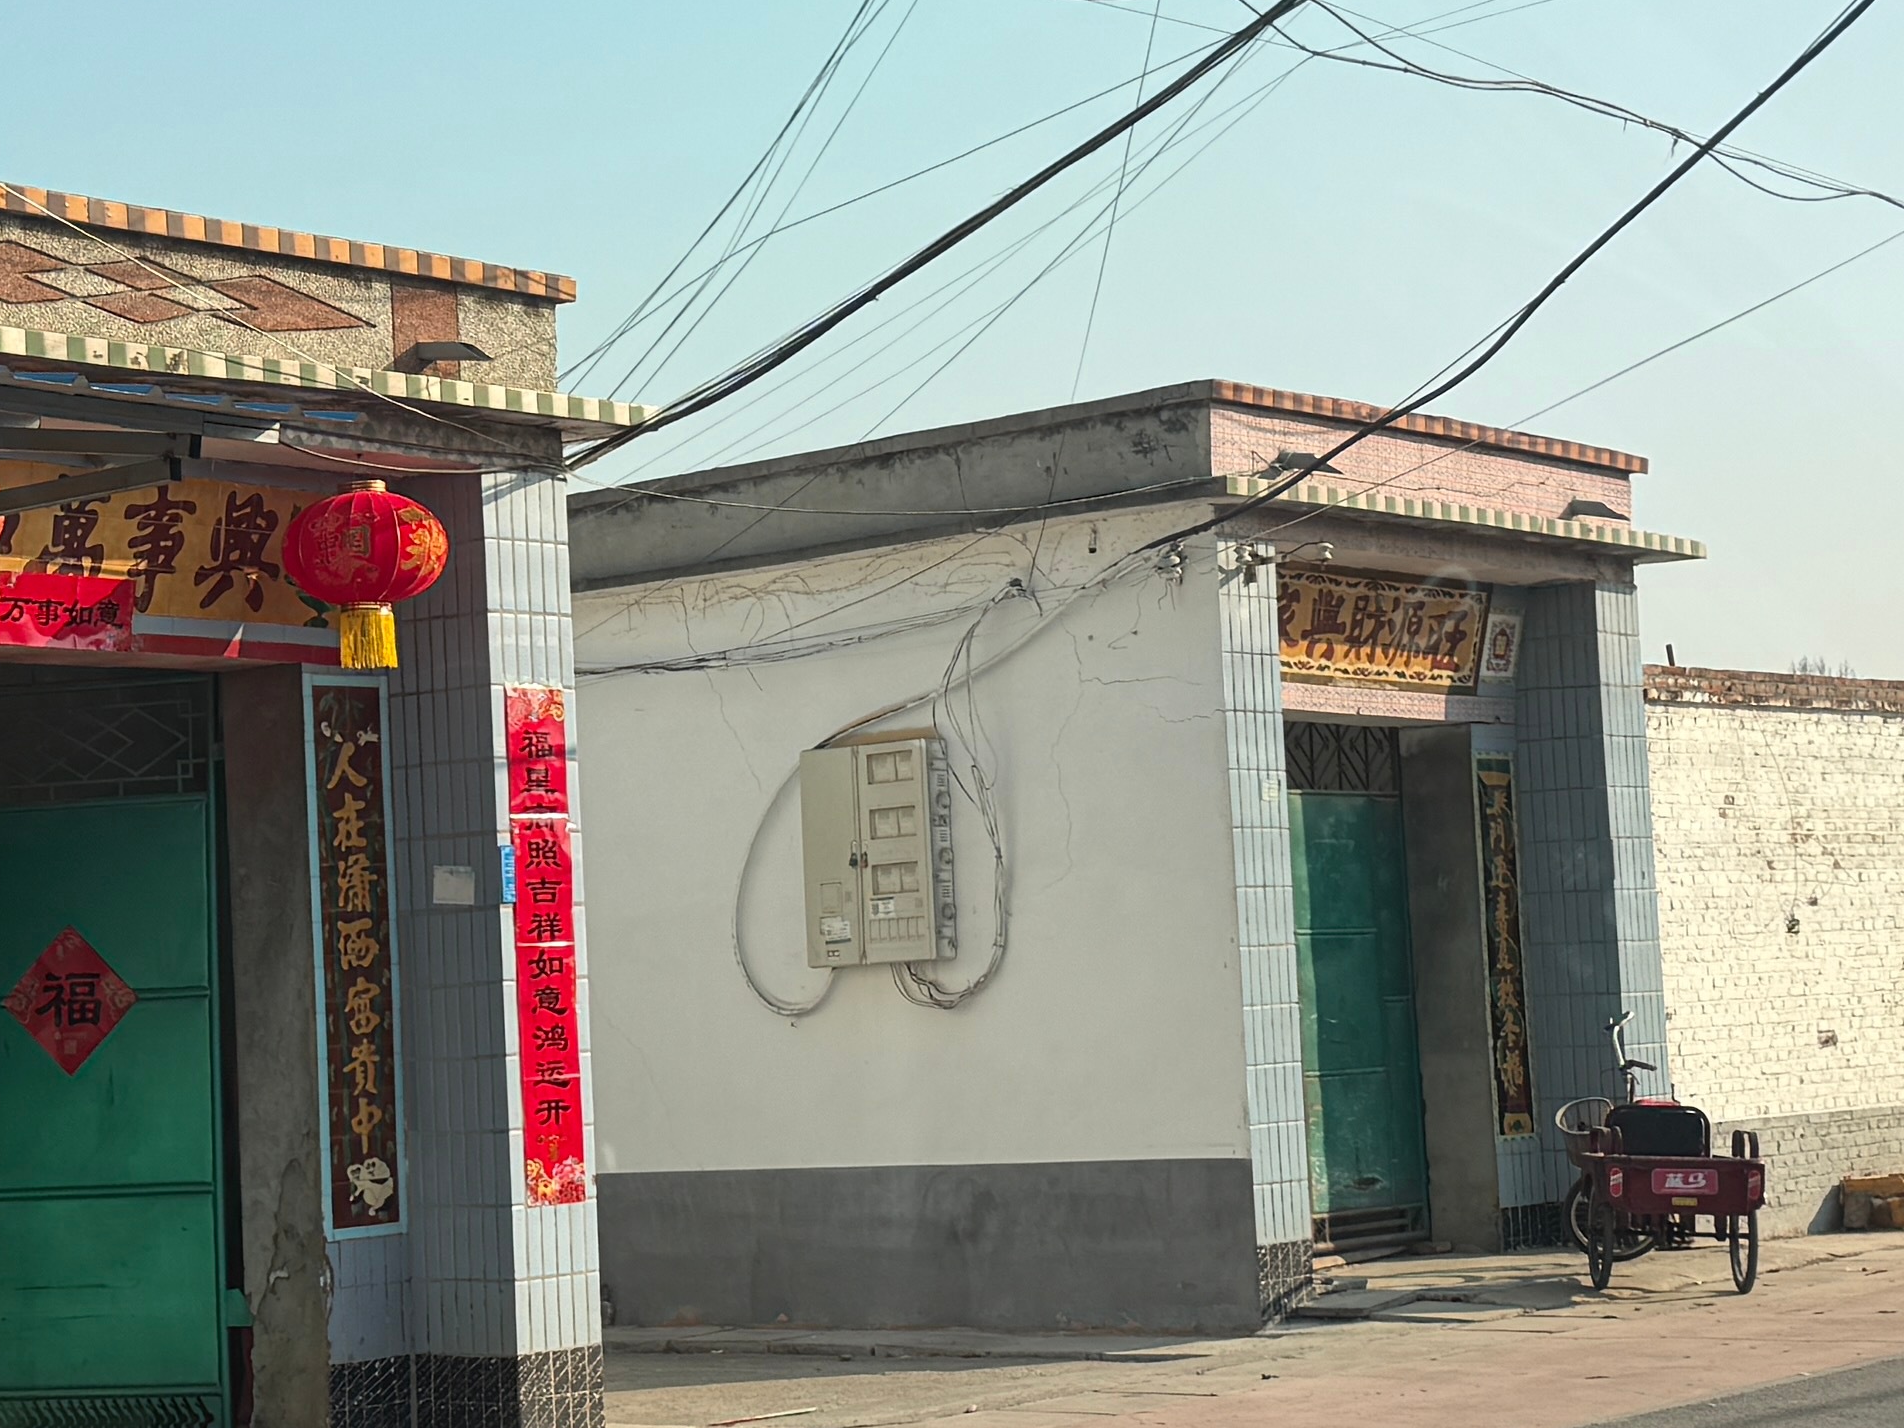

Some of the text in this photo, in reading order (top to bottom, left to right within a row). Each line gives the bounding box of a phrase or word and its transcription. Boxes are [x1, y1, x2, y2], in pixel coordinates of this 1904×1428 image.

[35, 972, 103, 1028] 福
[518, 729, 572, 1127] 福星高照吉祥如意鸿运开
